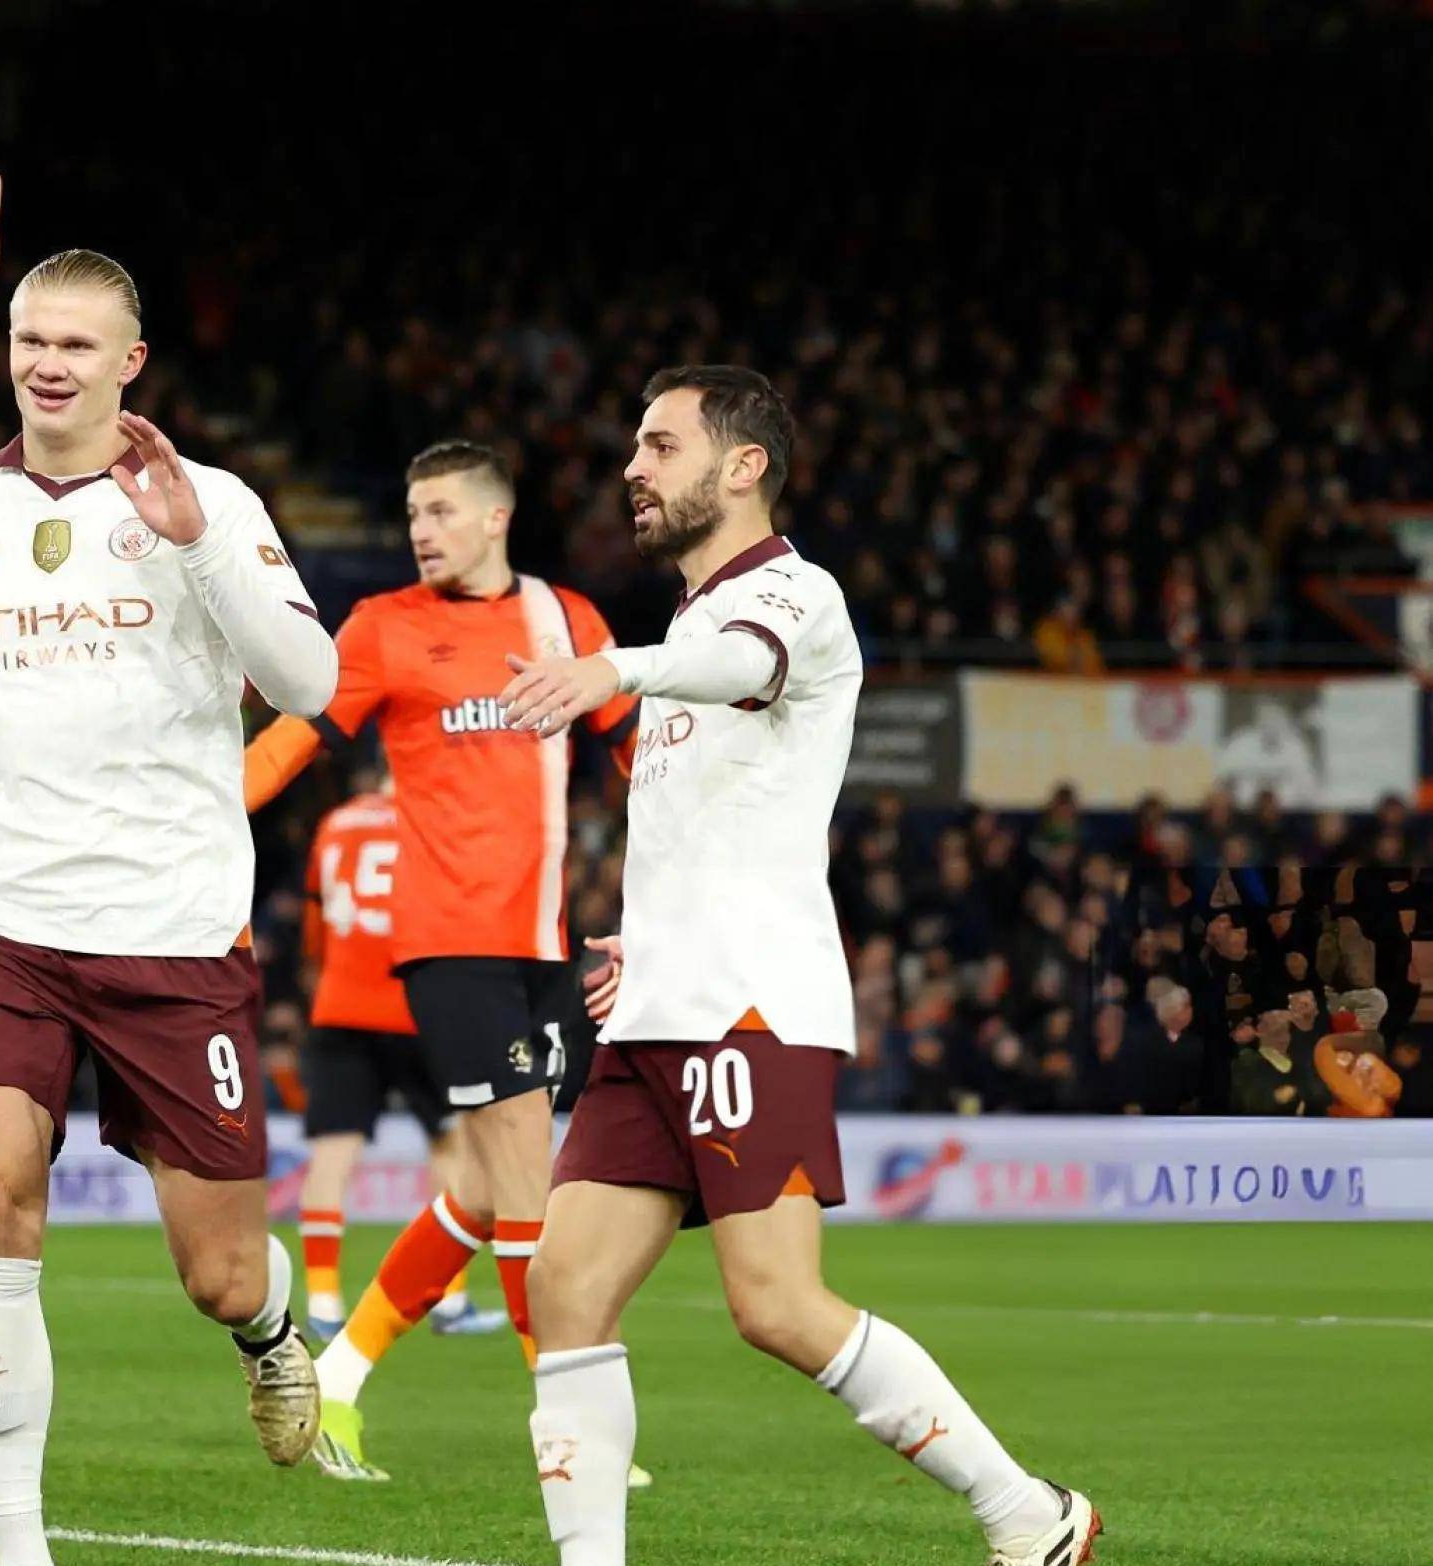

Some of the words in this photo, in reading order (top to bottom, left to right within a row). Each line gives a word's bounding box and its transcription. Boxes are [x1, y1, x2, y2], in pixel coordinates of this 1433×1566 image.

[320, 840, 400, 938] 45
[207, 1033, 243, 1110] 9
[682, 1048, 753, 1136] 20
